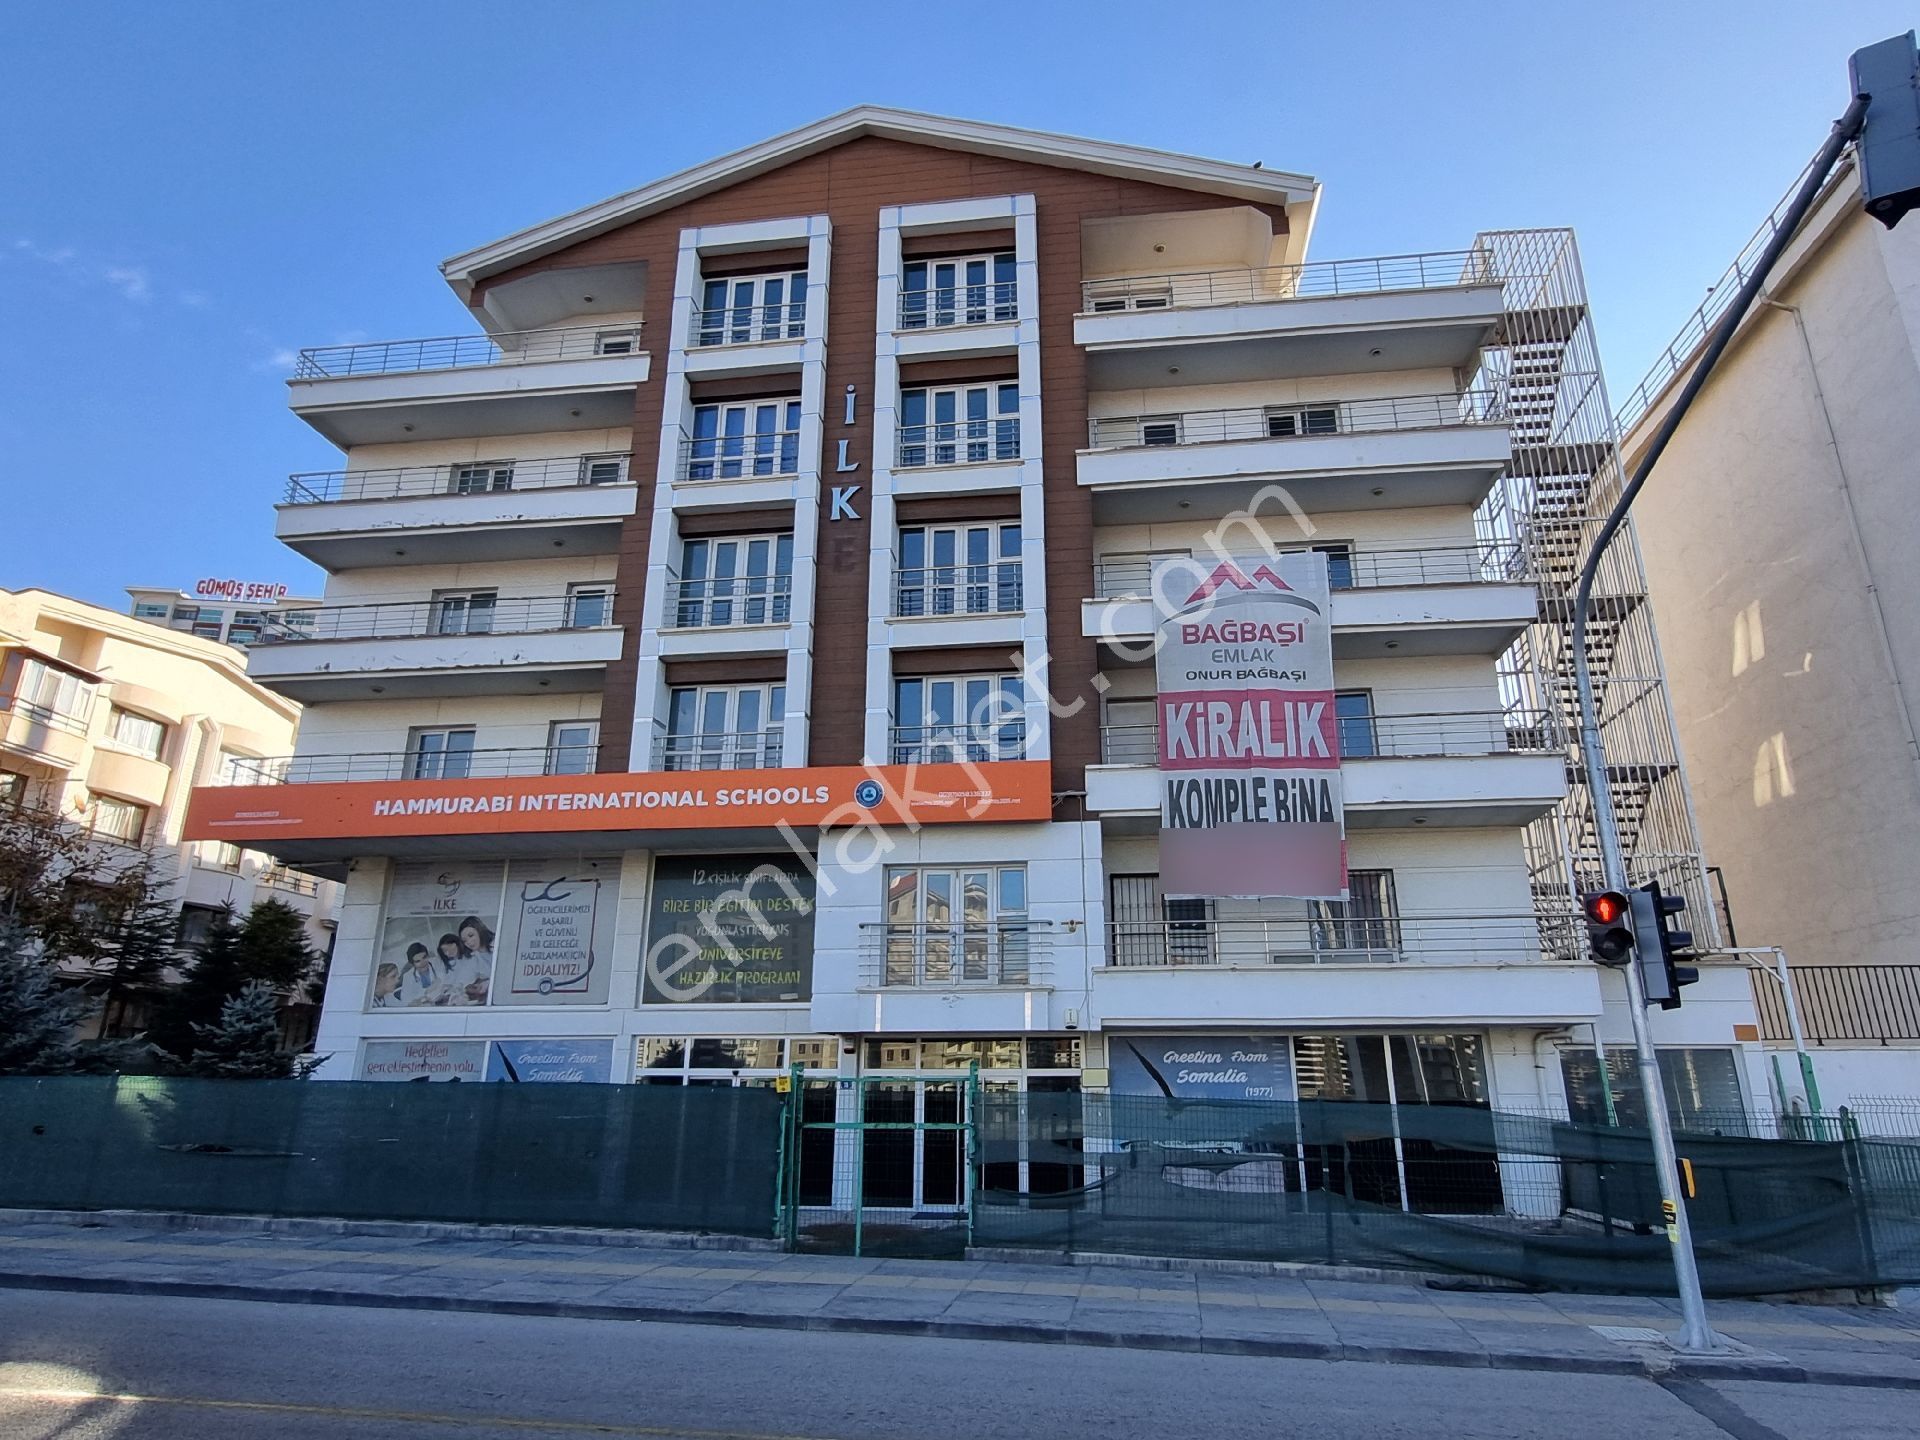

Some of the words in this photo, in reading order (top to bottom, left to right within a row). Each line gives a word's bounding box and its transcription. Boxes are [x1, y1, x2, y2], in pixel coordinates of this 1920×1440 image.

[1182, 620, 1304, 647] BAĞBAŞI
[1212, 648, 1274, 663] EMLAK
[1186, 670, 1233, 680] ONUR
[1237, 667, 1306, 682] BAĞBAŞI
[519, 790, 709, 811] INTERNATIONAL
[716, 786, 829, 806] SCHOOLS
[1168, 777, 1269, 828] KOMPLE
[692, 869, 706, 886] 12
[735, 970, 800, 984] PROGRAMI
[568, 1052, 598, 1064] From
[1230, 1050, 1268, 1063] From
[529, 1067, 583, 1081] Somalia
[1176, 1069, 1248, 1084] Somalia
[1245, 1086, 1273, 1097] (1977)
